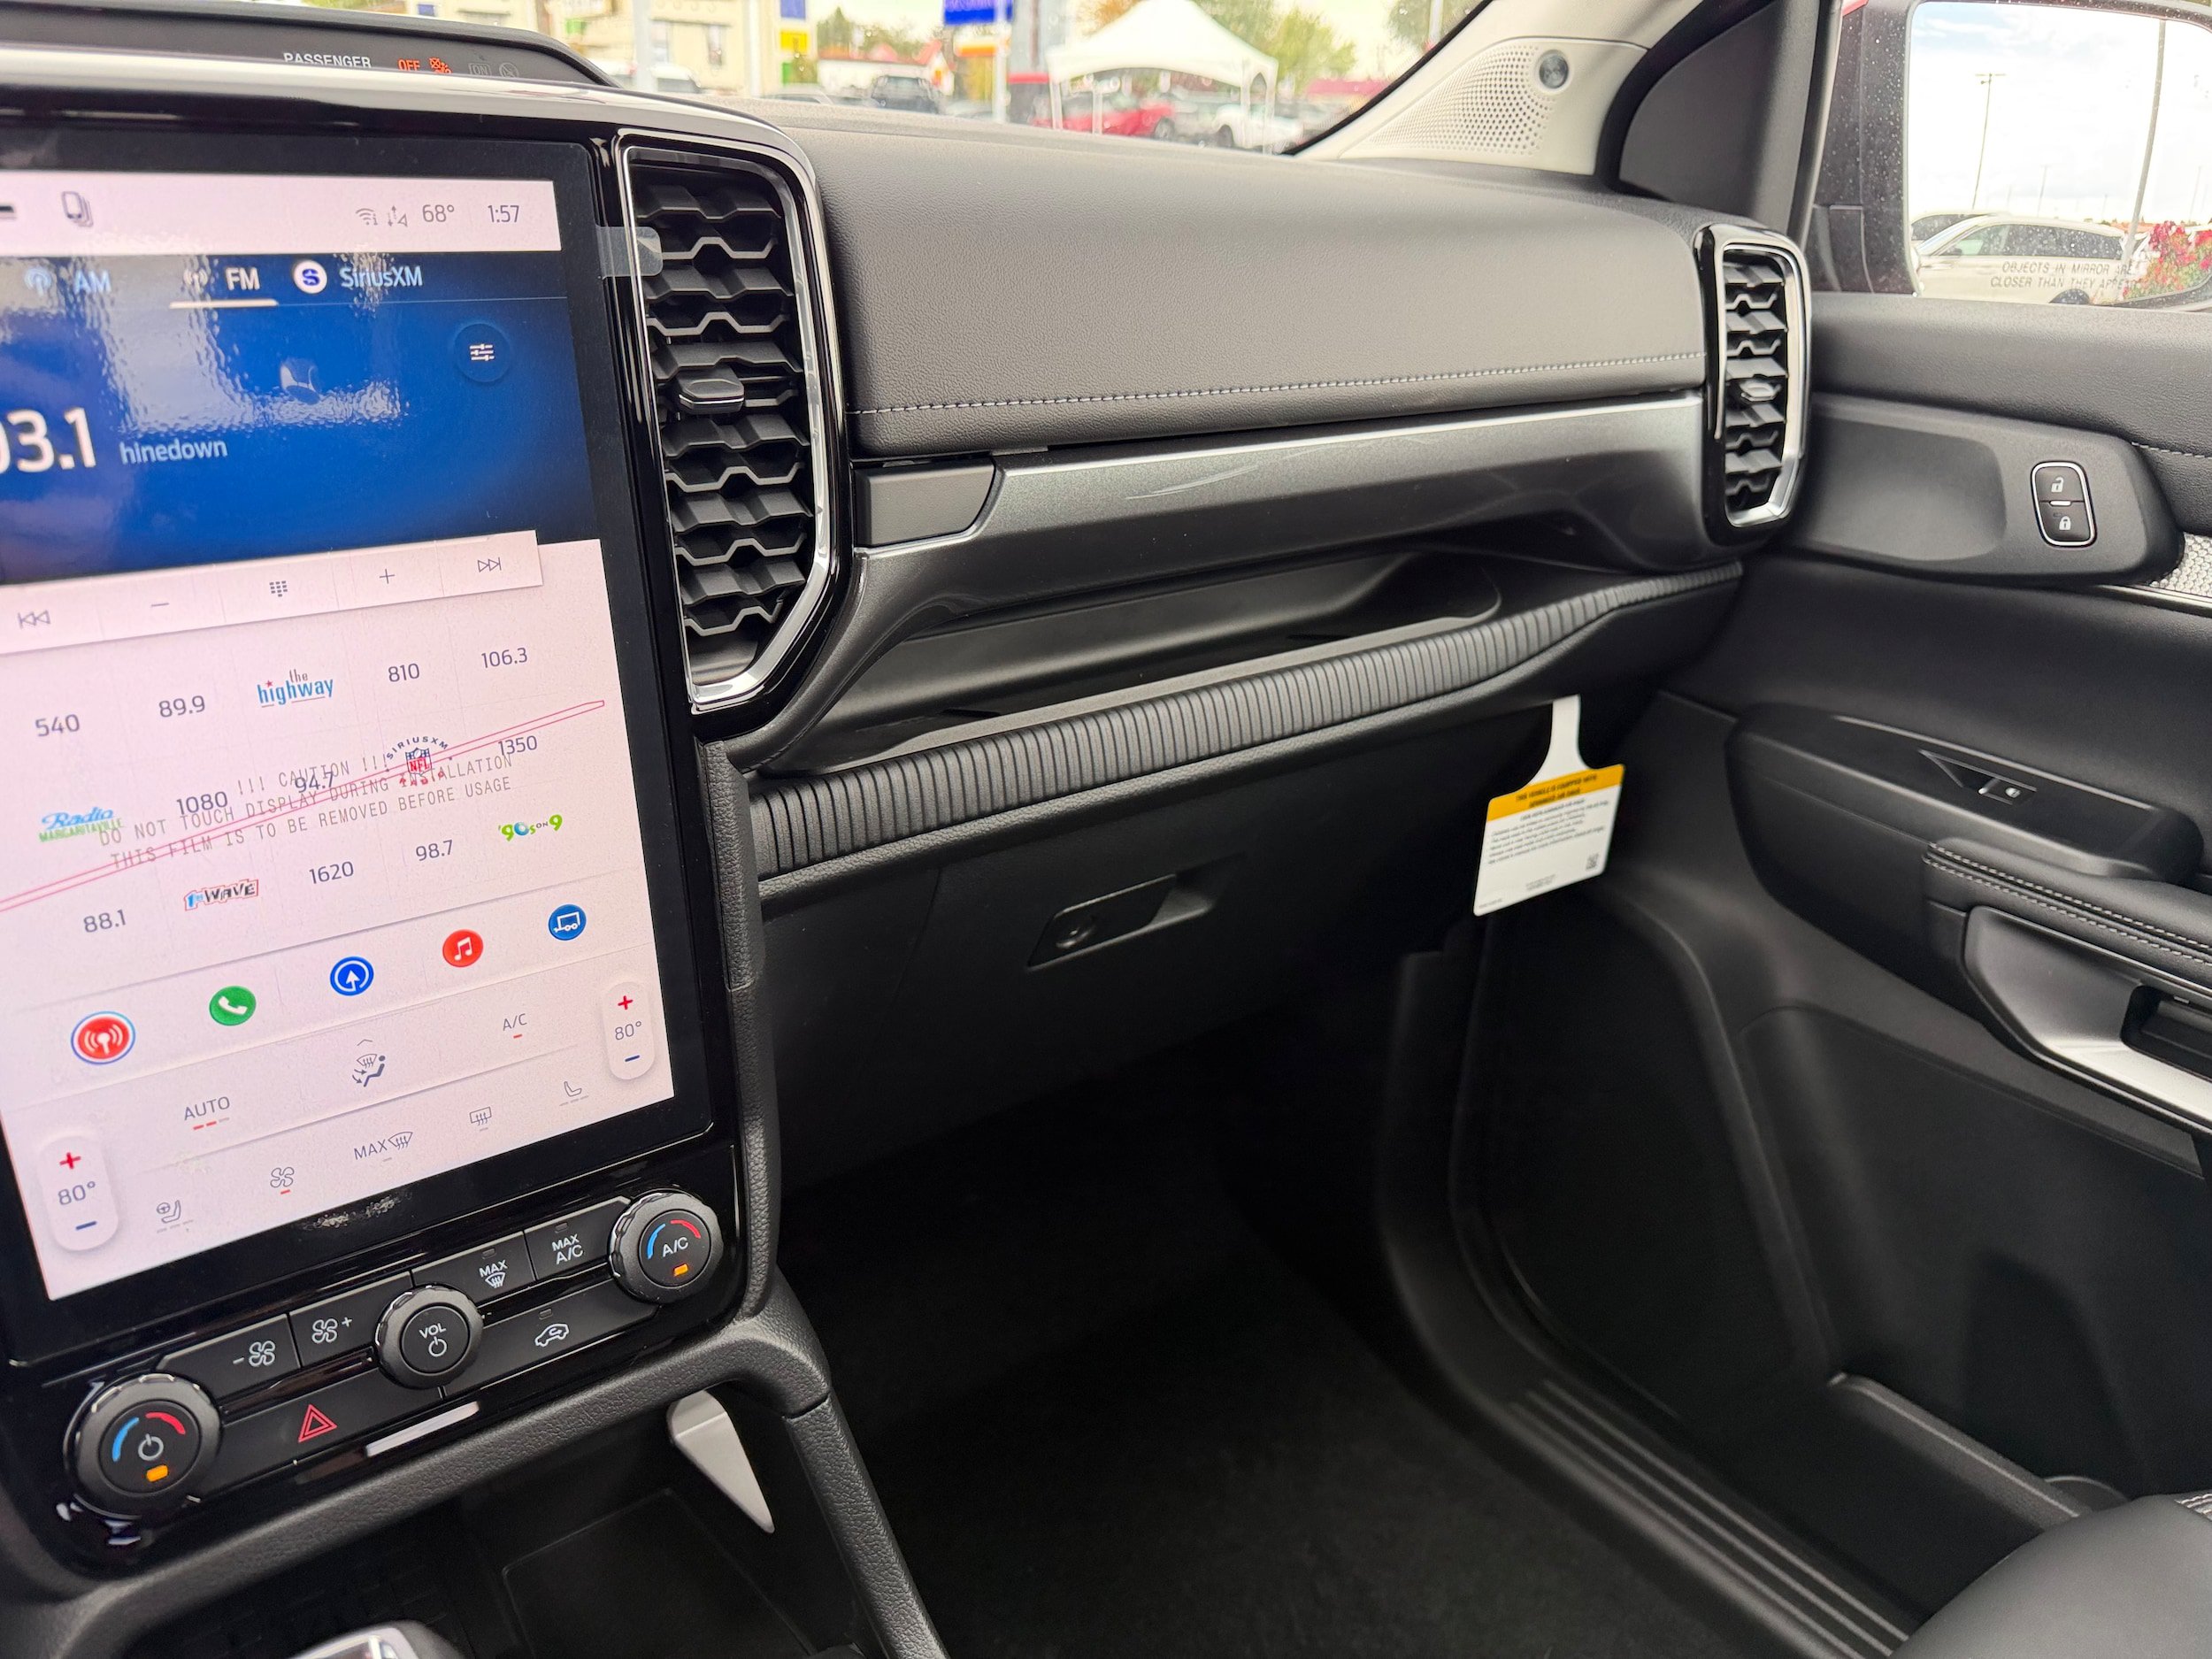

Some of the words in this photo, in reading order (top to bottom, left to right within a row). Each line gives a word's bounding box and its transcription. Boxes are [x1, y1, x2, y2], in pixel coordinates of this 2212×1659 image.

[283, 53, 372, 68] PASSENGER
[398, 59, 420, 71] OFF
[422, 204, 455, 222] 68°
[488, 204, 519, 223] 1:57
[340, 265, 423, 288] SiriusXM
[2001, 261, 2050, 273] OBJECTS
[2055, 262, 2066, 273] IN
[2070, 263, 2110, 274] MIRROR
[74, 269, 111, 293] AM
[226, 266, 261, 291] FM
[1990, 276, 2032, 288] CLOSER
[2038, 277, 2064, 288] THAN
[2070, 278, 2096, 288] THEY
[0, 407, 96, 474] 3.1
[481, 648, 528, 668] 106.3
[288, 669, 308, 683] the
[388, 663, 420, 682] 810
[257, 678, 334, 705] highway
[158, 695, 206, 718] 89.9
[35, 714, 81, 737] 540
[387, 736, 449, 759] SIRIUSXM
[498, 735, 538, 755] 1350
[279, 760, 349, 787] CAUTION
[408, 757, 430, 772] NFL
[295, 772, 335, 793] 94.7
[99, 827, 122, 846] DO
[134, 818, 166, 839] NOT
[180, 807, 235, 830] TOUCH
[246, 792, 317, 818] DISPLAY
[329, 778, 389, 802] DURING
[399, 754, 513, 787] INSTALLATION
[177, 791, 228, 815] 1080
[42, 806, 114, 830] Radio
[111, 846, 157, 869] THIS
[169, 839, 213, 857] FILM
[227, 829, 245, 847] IS
[256, 822, 277, 841] TO
[288, 816, 309, 833] BE
[319, 801, 388, 827] REMOVED
[399, 791, 456, 811] BEFORE
[465, 777, 512, 796] USAGE
[549, 814, 563, 832] 9
[415, 840, 453, 861] 98.7
[309, 861, 355, 884] 1620
[83, 909, 127, 933] 88.1
[502, 1013, 527, 1031] A/C
[614, 1020, 642, 1041] 80°
[183, 1096, 231, 1121] AUTO
[354, 1138, 388, 1160] MAX
[58, 1180, 96, 1205] 80°
[552, 1234, 580, 1251] MAX
[662, 1237, 689, 1257] A/C
[556, 1244, 584, 1265] A/C
[479, 1260, 508, 1278] MAX
[419, 1323, 447, 1339] VOL
